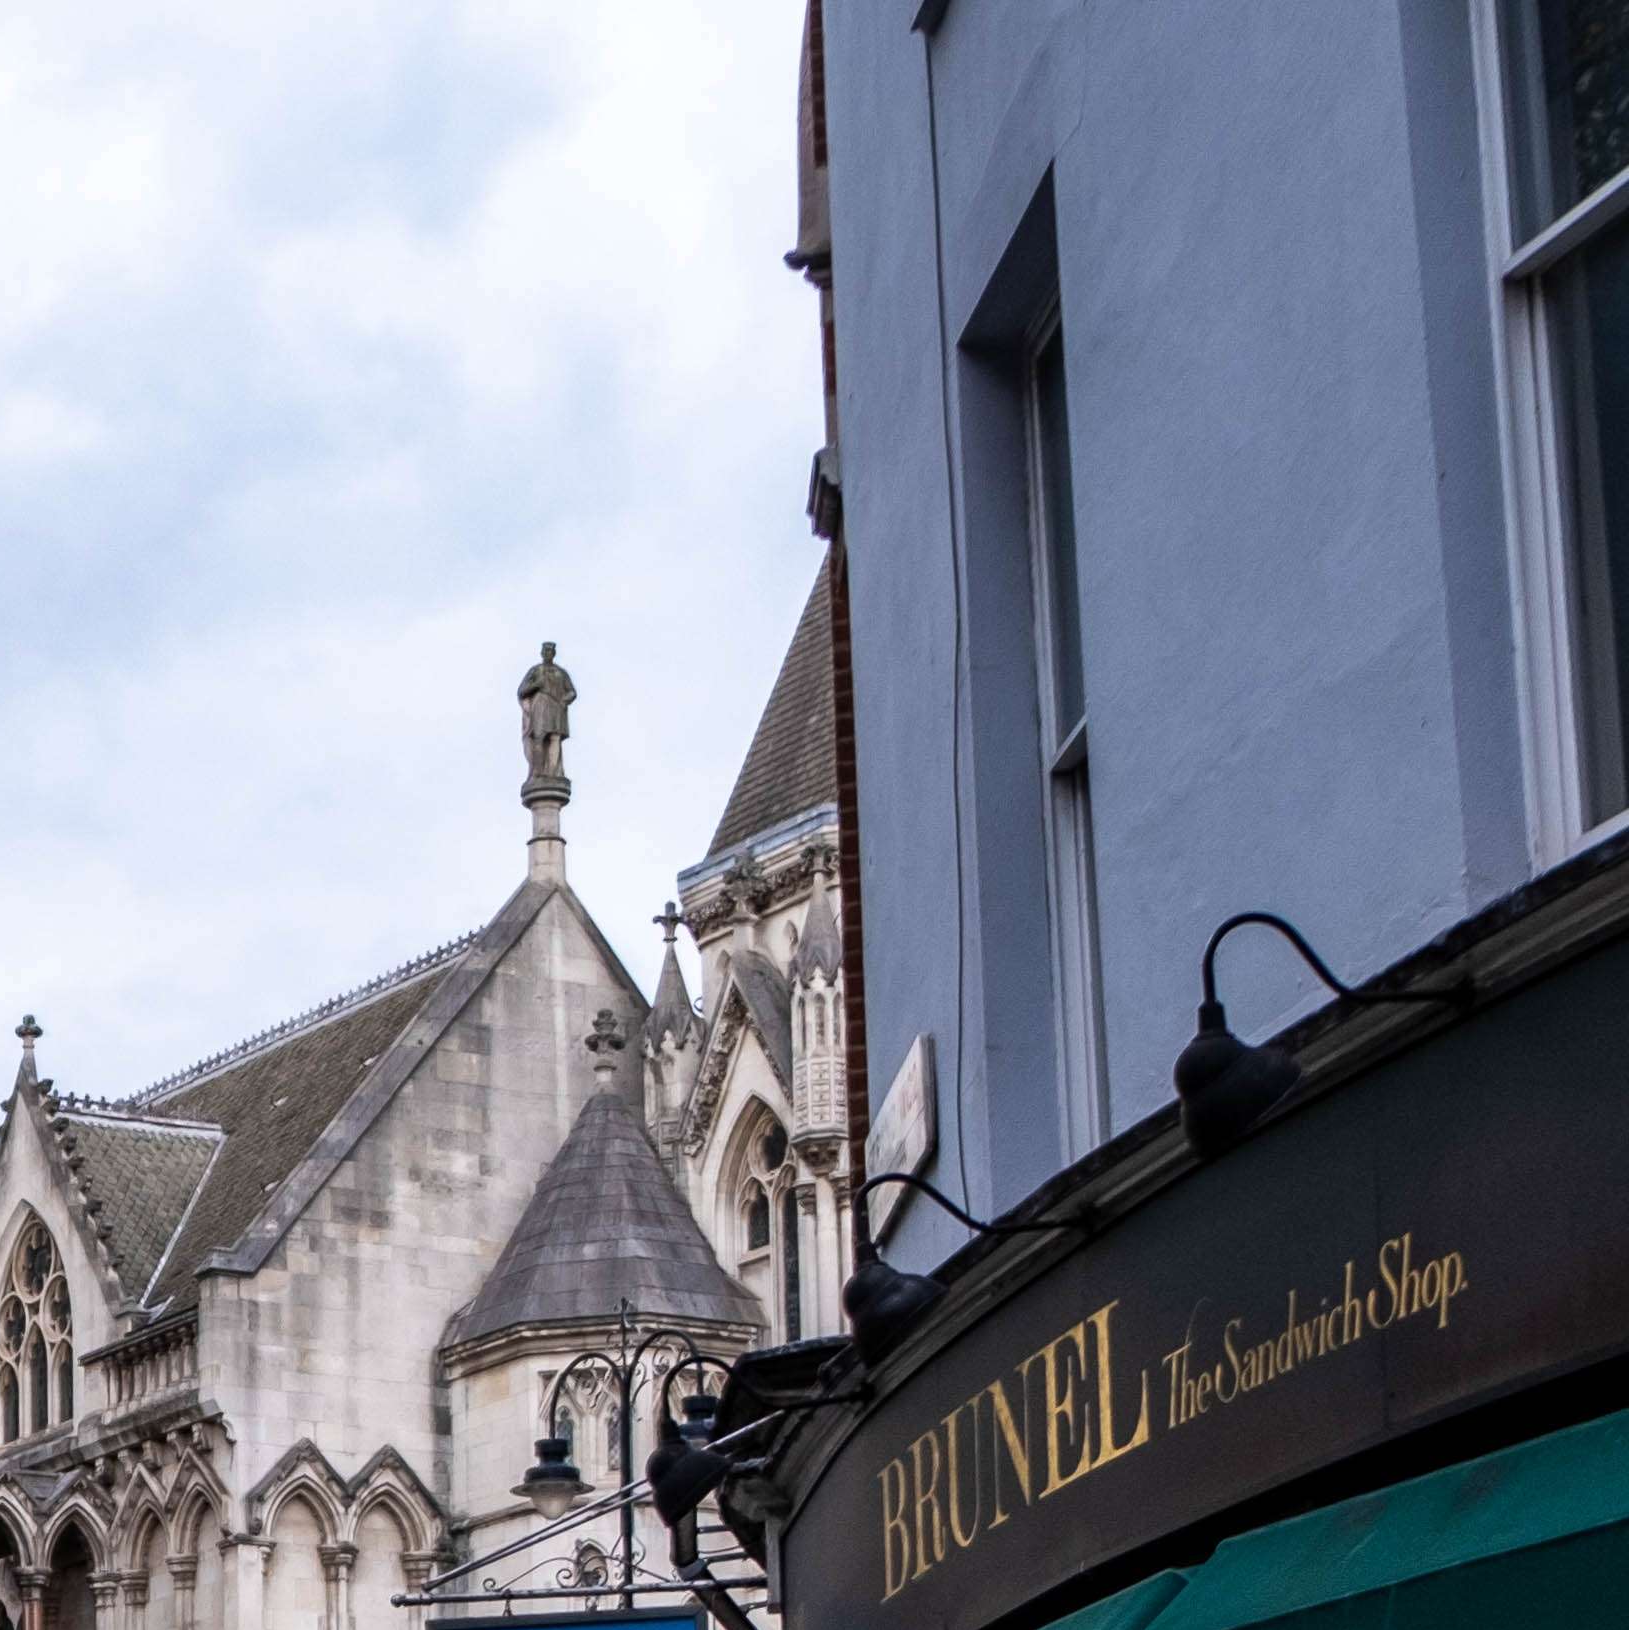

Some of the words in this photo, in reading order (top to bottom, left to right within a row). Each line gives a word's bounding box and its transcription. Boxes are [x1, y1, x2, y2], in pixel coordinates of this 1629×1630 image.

[877, 1299, 1150, 1603] BRUNEL
[1162, 1298, 1213, 1429] The
[1214, 1261, 1362, 1404] Sandwich
